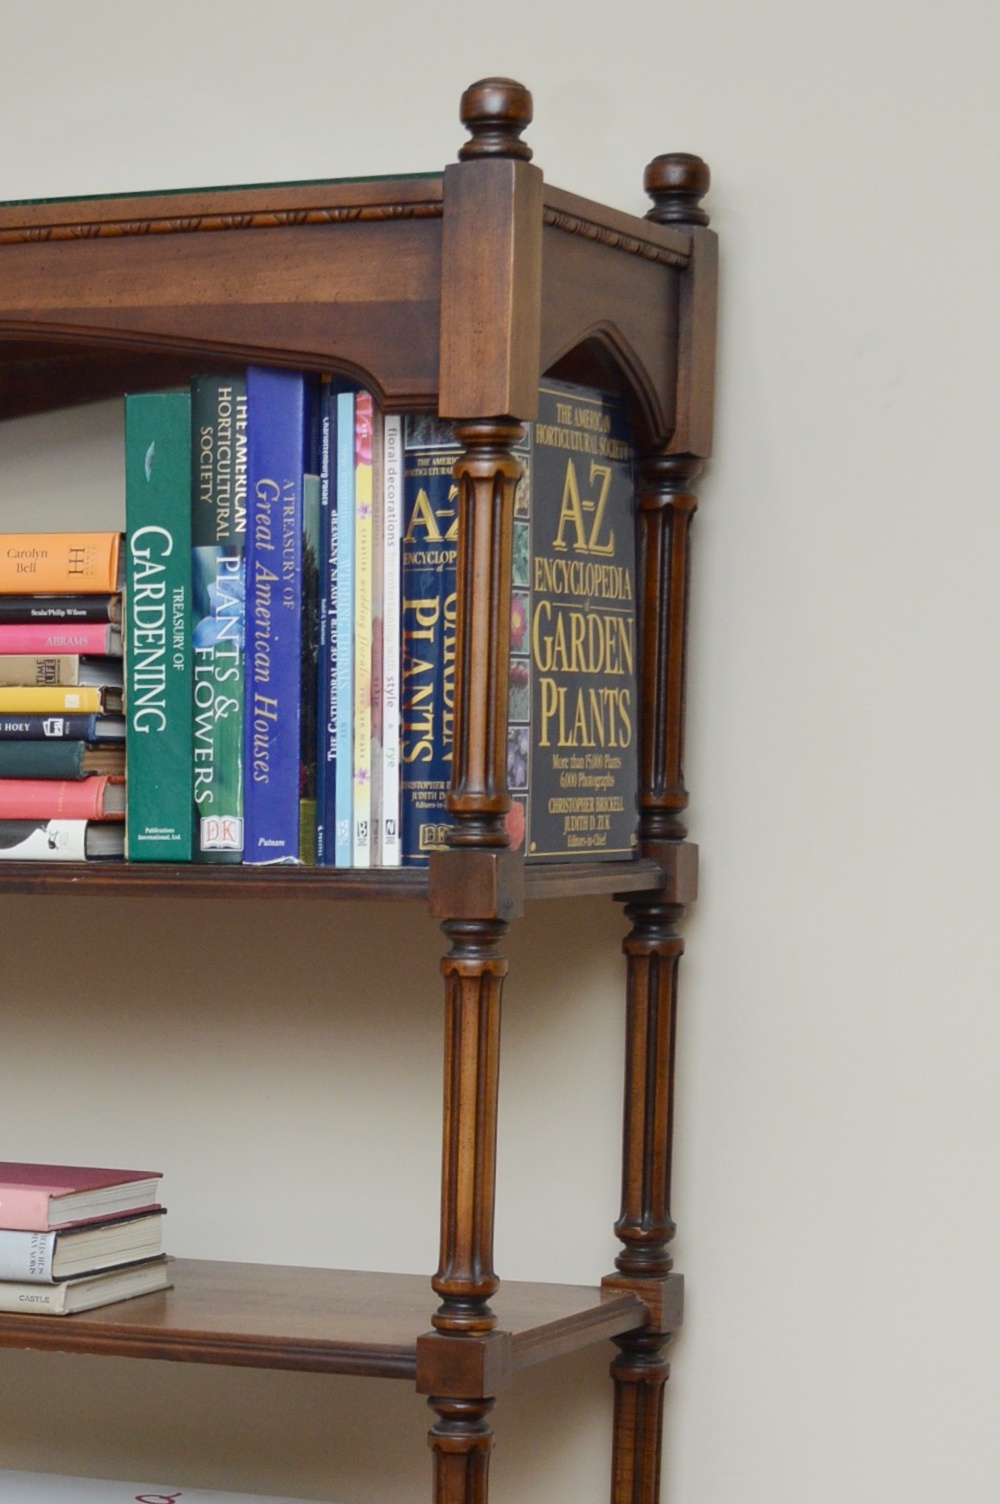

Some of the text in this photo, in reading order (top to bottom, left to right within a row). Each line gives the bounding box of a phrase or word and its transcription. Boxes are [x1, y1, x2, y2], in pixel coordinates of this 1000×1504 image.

[557, 403, 572, 425] THE
[387, 428, 397, 465] floral
[536, 424, 598, 454] HORTICULTURAL
[200, 426, 213, 504] SOCIETY
[216, 387, 232, 541] HORTICULTURAL
[234, 396, 247, 533] THE AMERICAN
[386, 467, 397, 548] decorations
[553, 458, 615, 557] A-Z
[7, 548, 48, 561] Carolyn
[282, 478, 295, 610] A TREASURY OF
[360, 529, 368, 572] creative
[403, 551, 457, 565] ENCYCLOP
[16, 562, 37, 573] Bell
[534, 557, 632, 600] ENCYCLOPEDIA
[45, 636, 88, 646] ABRAMS
[130, 525, 174, 734] GARDENING
[173, 586, 184, 671] TREASURY OF
[214, 555, 240, 723] PLANTS &
[253, 478, 280, 784] Great American Houses
[532, 600, 633, 675] GARDEN
[36, 659, 44, 684] TIME
[45, 659, 55, 683] LIFE
[402, 597, 440, 764] PLANTS
[385, 676, 396, 708] style
[5, 723, 30, 732] HOEY
[194, 646, 215, 804] FLOWERS
[538, 678, 632, 748] PLANTS
[385, 747, 396, 768] rye
[548, 797, 595, 813] CHRISTOPHER
[206, 820, 236, 843] DK
[258, 837, 285, 847] Putnam
[19, 1295, 50, 1303] CASTLE
